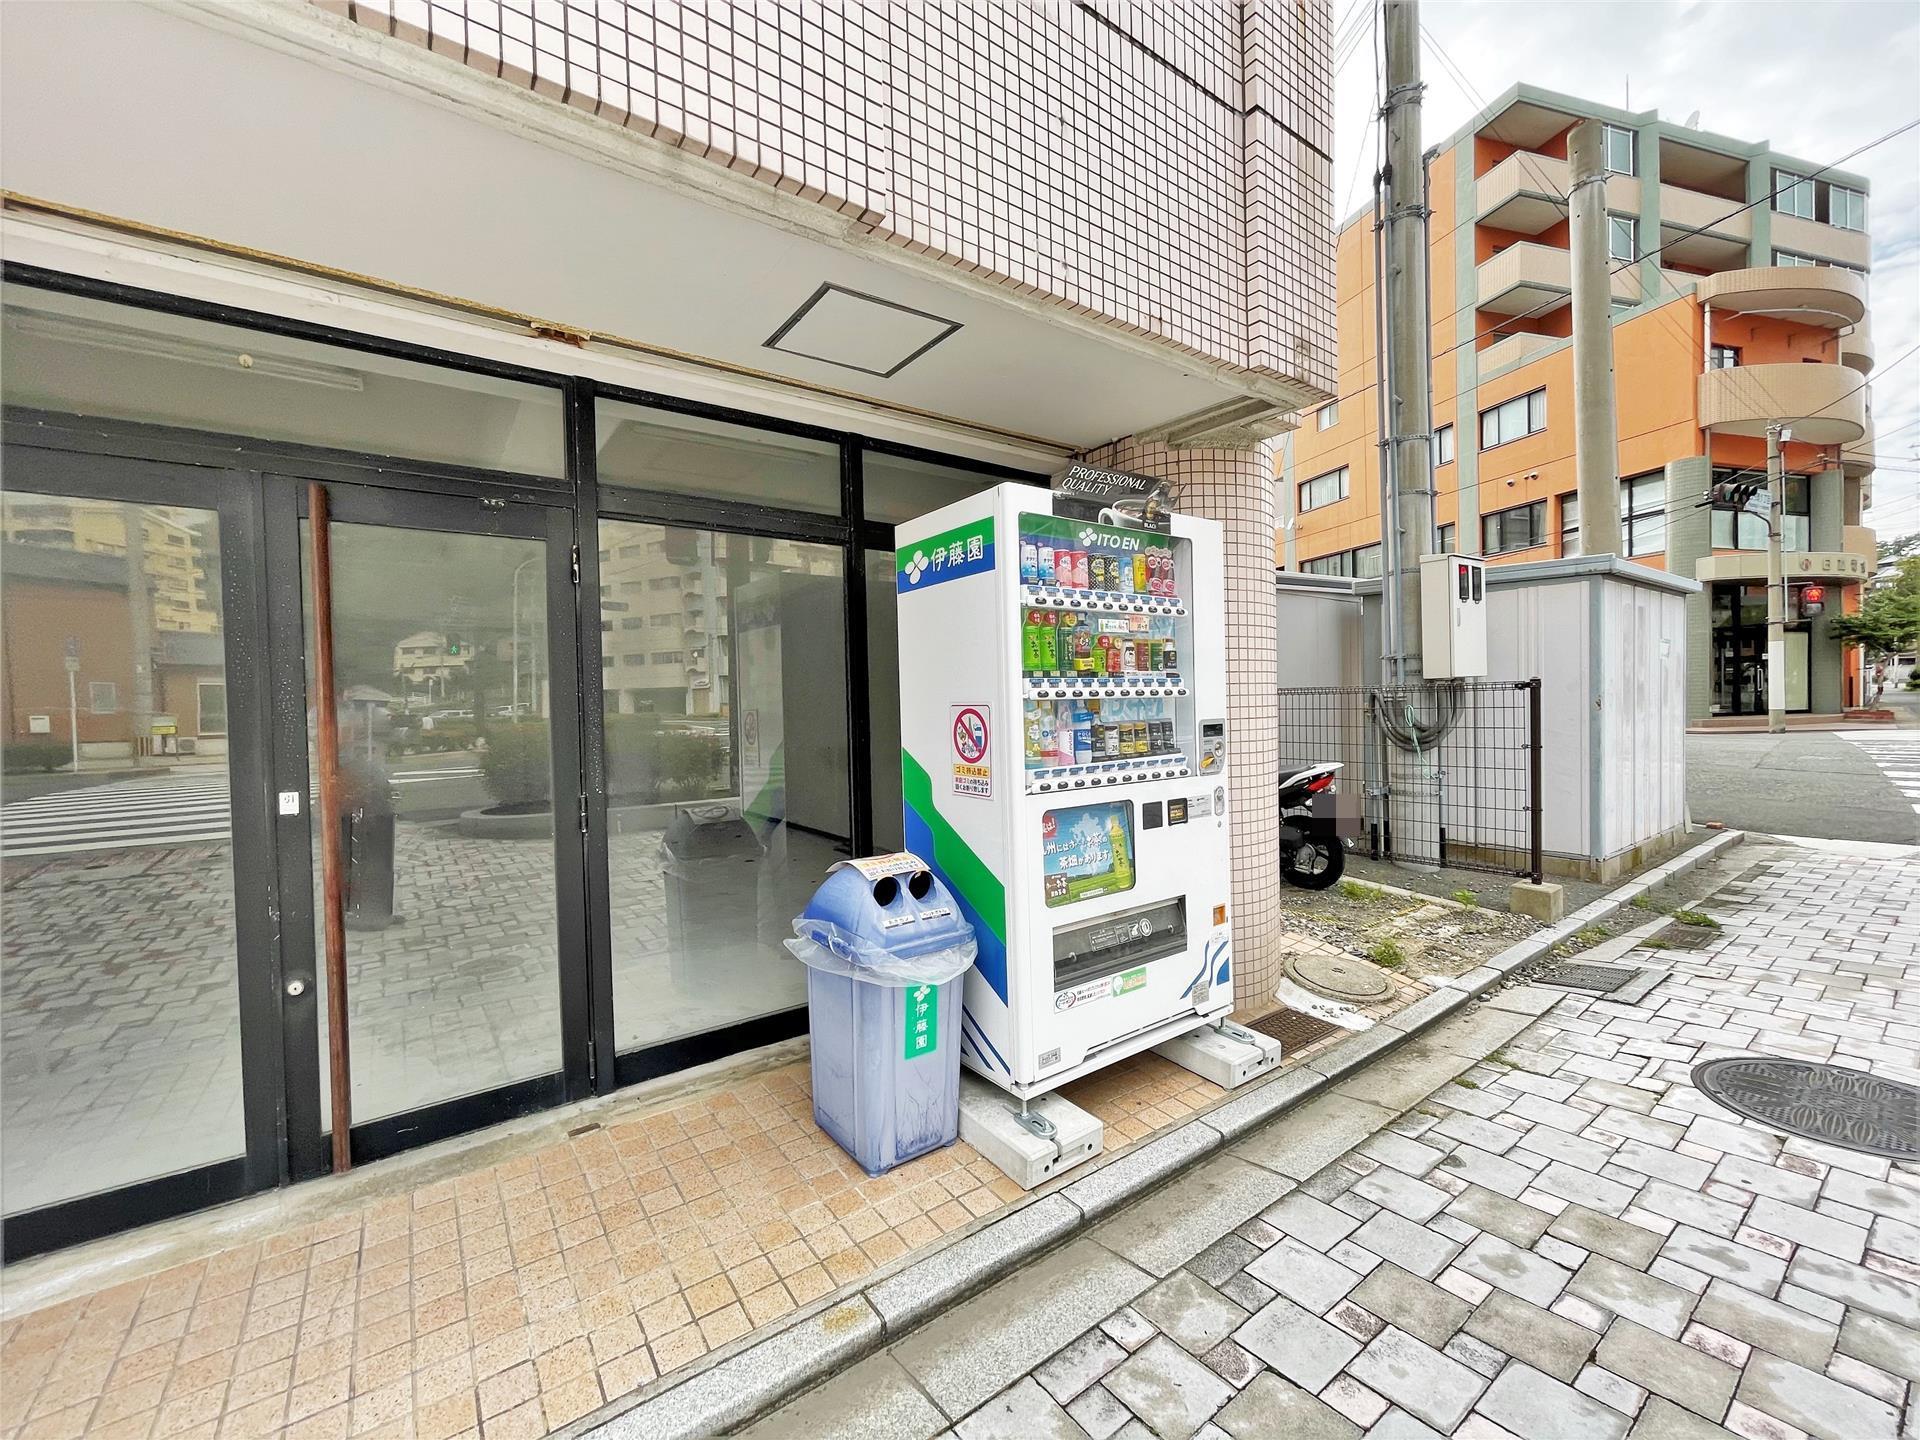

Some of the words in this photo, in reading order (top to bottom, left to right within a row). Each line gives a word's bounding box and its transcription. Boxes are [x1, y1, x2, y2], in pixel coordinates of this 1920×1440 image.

[1062, 478, 1112, 496] QUALITY
[1069, 466, 1146, 490] PROFESSIONAL
[1097, 533, 1120, 548] ITO
[1122, 538, 1140, 551] EN
[930, 535, 983, 572] 伊藤園
[956, 766, 988, 777] ゴミ持込禁止
[1059, 850, 1110, 869] 茶畑があります
[915, 1003, 929, 1049] 伊藤園
